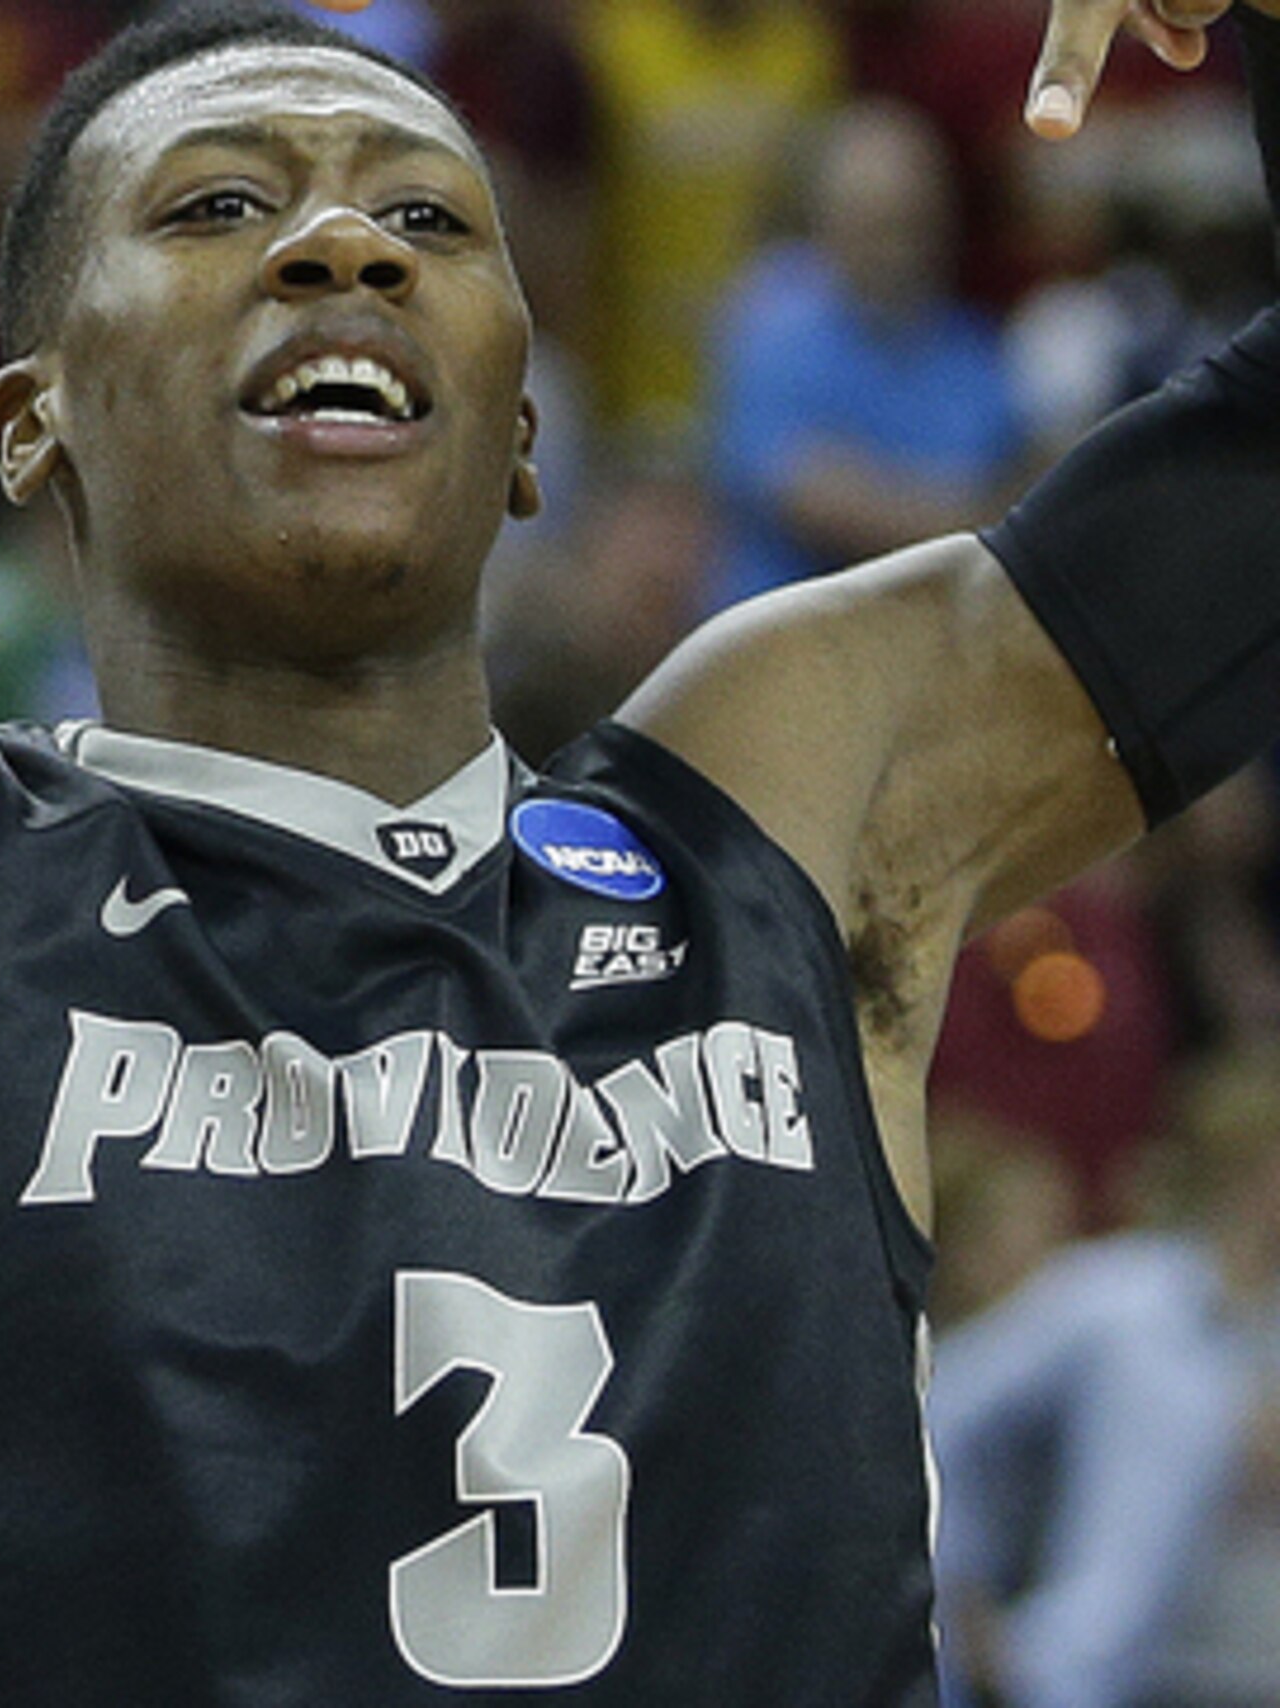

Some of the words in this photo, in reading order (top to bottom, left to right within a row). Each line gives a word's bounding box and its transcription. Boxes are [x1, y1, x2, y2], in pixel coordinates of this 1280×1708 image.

[541, 844, 657, 876] NCAA
[580, 925, 659, 952] BIG
[19, 1008, 816, 1205] PROVIDENCE
[389, 1269, 631, 1688] 3
